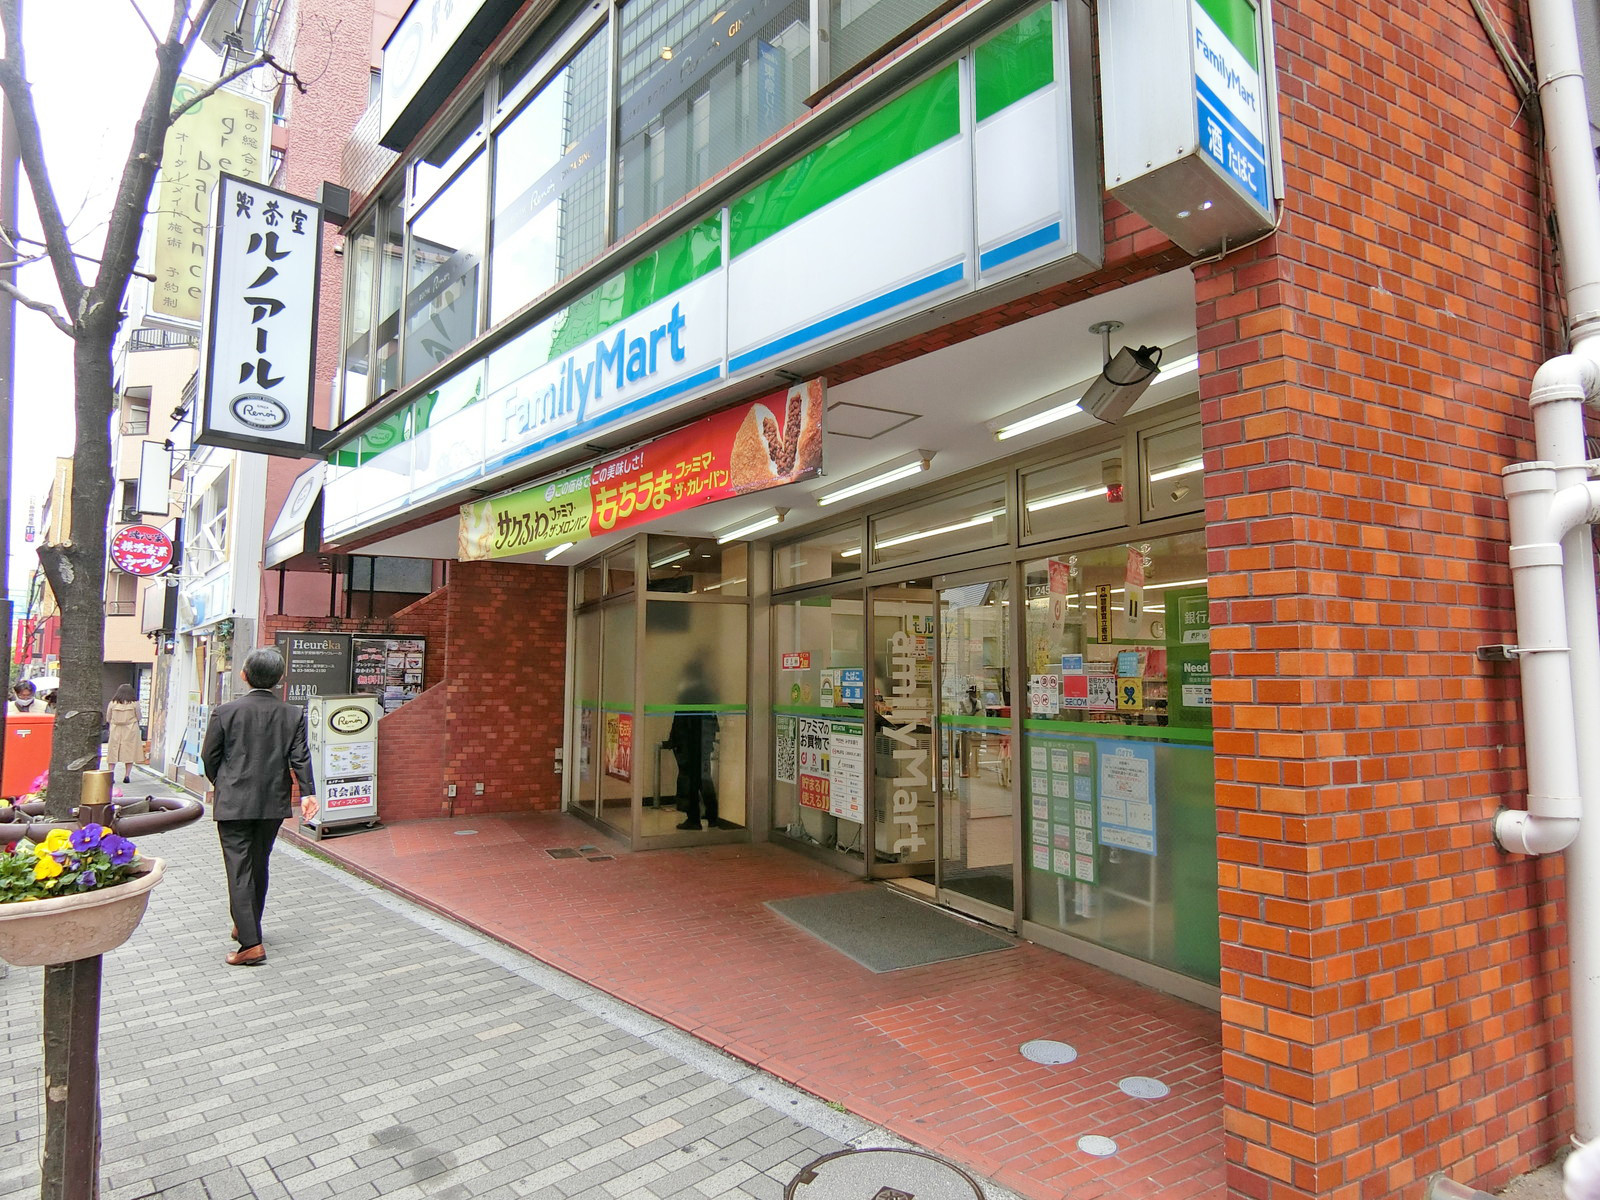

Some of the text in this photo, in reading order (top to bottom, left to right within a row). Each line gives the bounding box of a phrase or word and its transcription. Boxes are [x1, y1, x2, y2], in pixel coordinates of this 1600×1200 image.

[1196, 27, 1256, 113] FamilyMart
[1207, 116, 1257, 192] 酒 たばこ
[236, 190, 308, 235] 喫茶室
[187, 150, 211, 299] balance
[162, 267, 180, 309] 予約制
[238, 231, 293, 390] ルノアール
[502, 301, 687, 441] FamilyMart
[595, 469, 673, 530] もちうま
[122, 554, 164, 569] ラーメン
[293, 639, 341, 650] Heurêka
[1183, 662, 1209, 673] Need
[288, 684, 318, 696] A&PRO
[1064, 698, 1088, 706] SECOM
[800, 719, 830, 736] ファミマの
[800, 735, 830, 751] お買物で
[327, 785, 372, 799] 貸会議室
[801, 775, 829, 795] 貯まる!!
[801, 791, 829, 810] 使える!!
